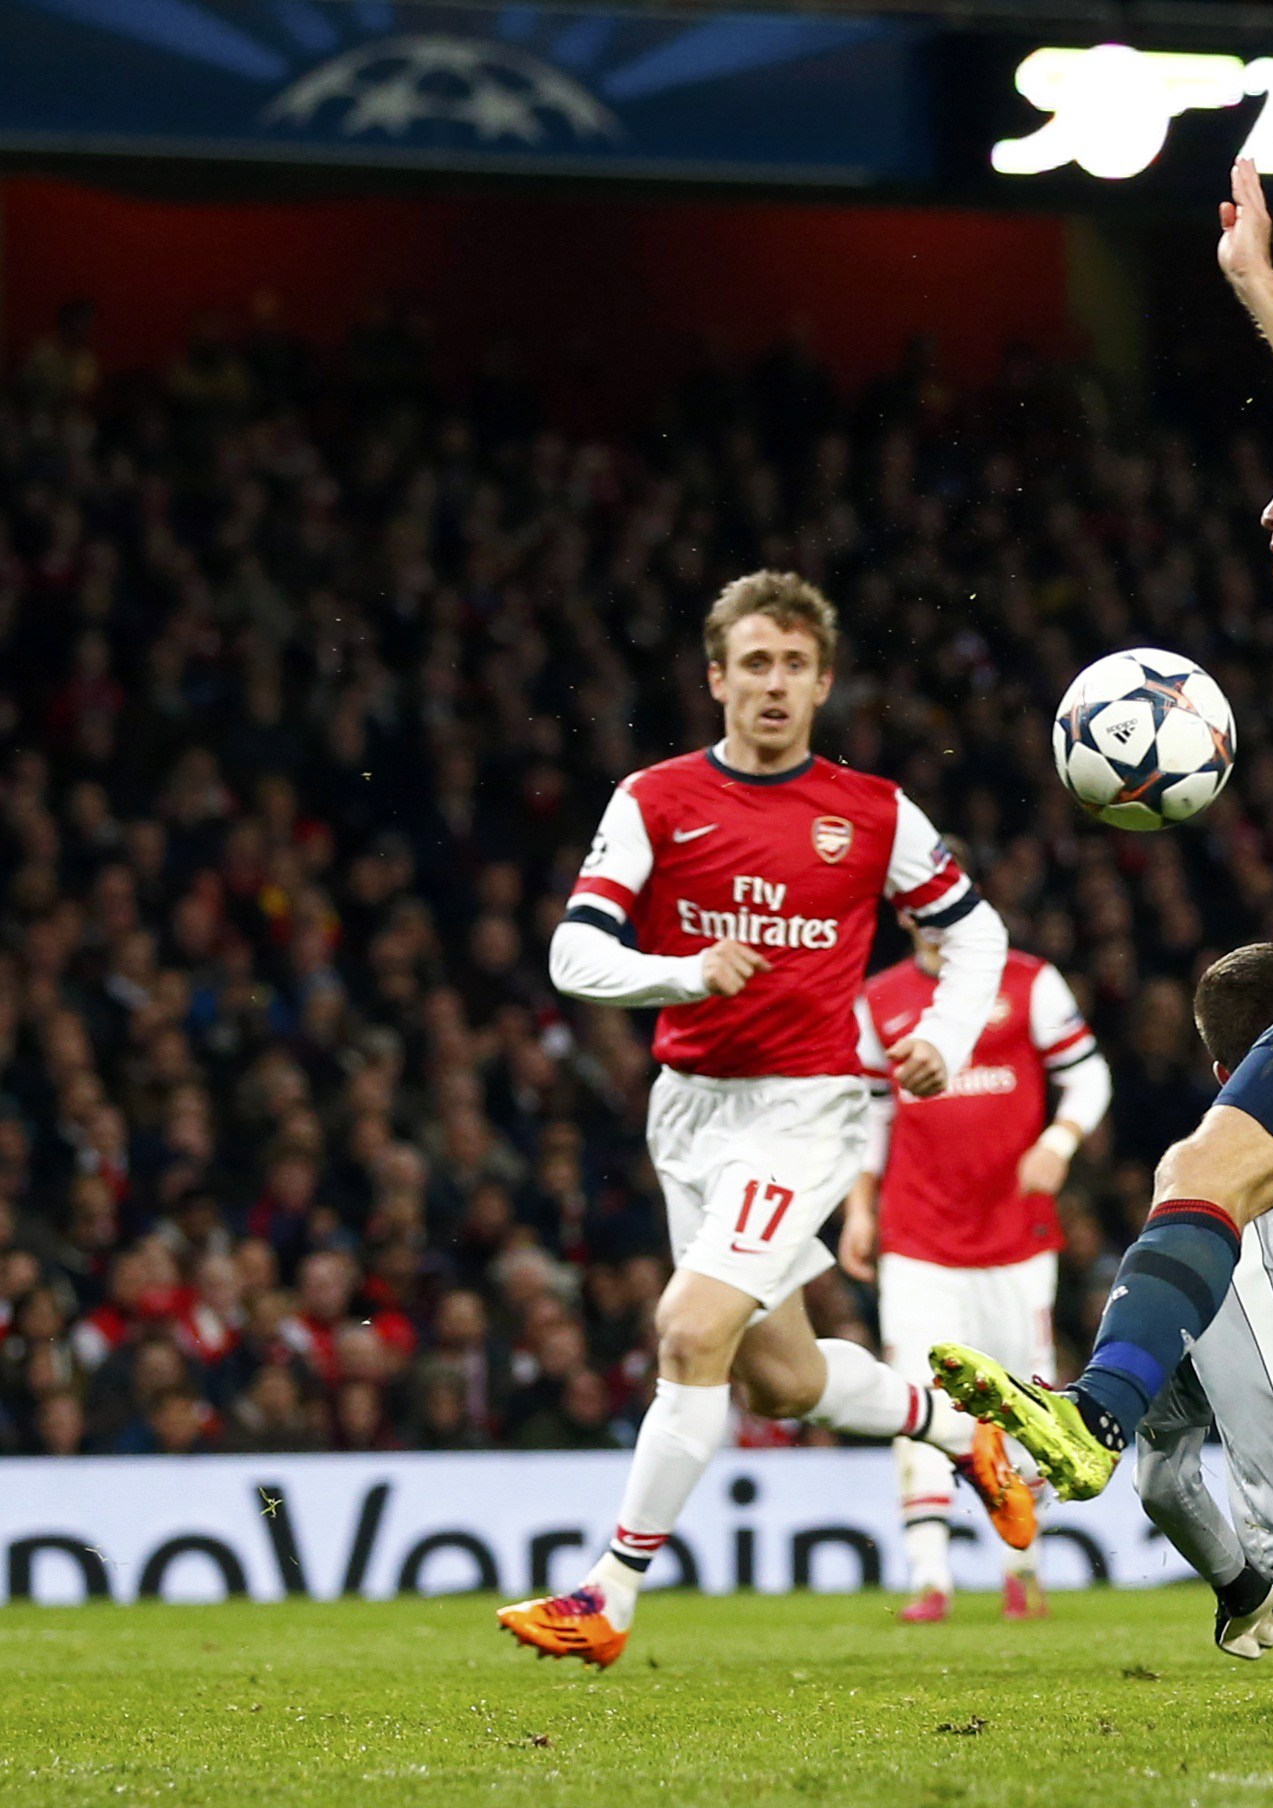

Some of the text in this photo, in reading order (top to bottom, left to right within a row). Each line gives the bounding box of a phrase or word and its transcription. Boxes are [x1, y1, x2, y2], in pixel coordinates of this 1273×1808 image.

[733, 875, 787, 911] Fly
[677, 898, 839, 950] Emirates
[735, 1179, 794, 1242] 17
